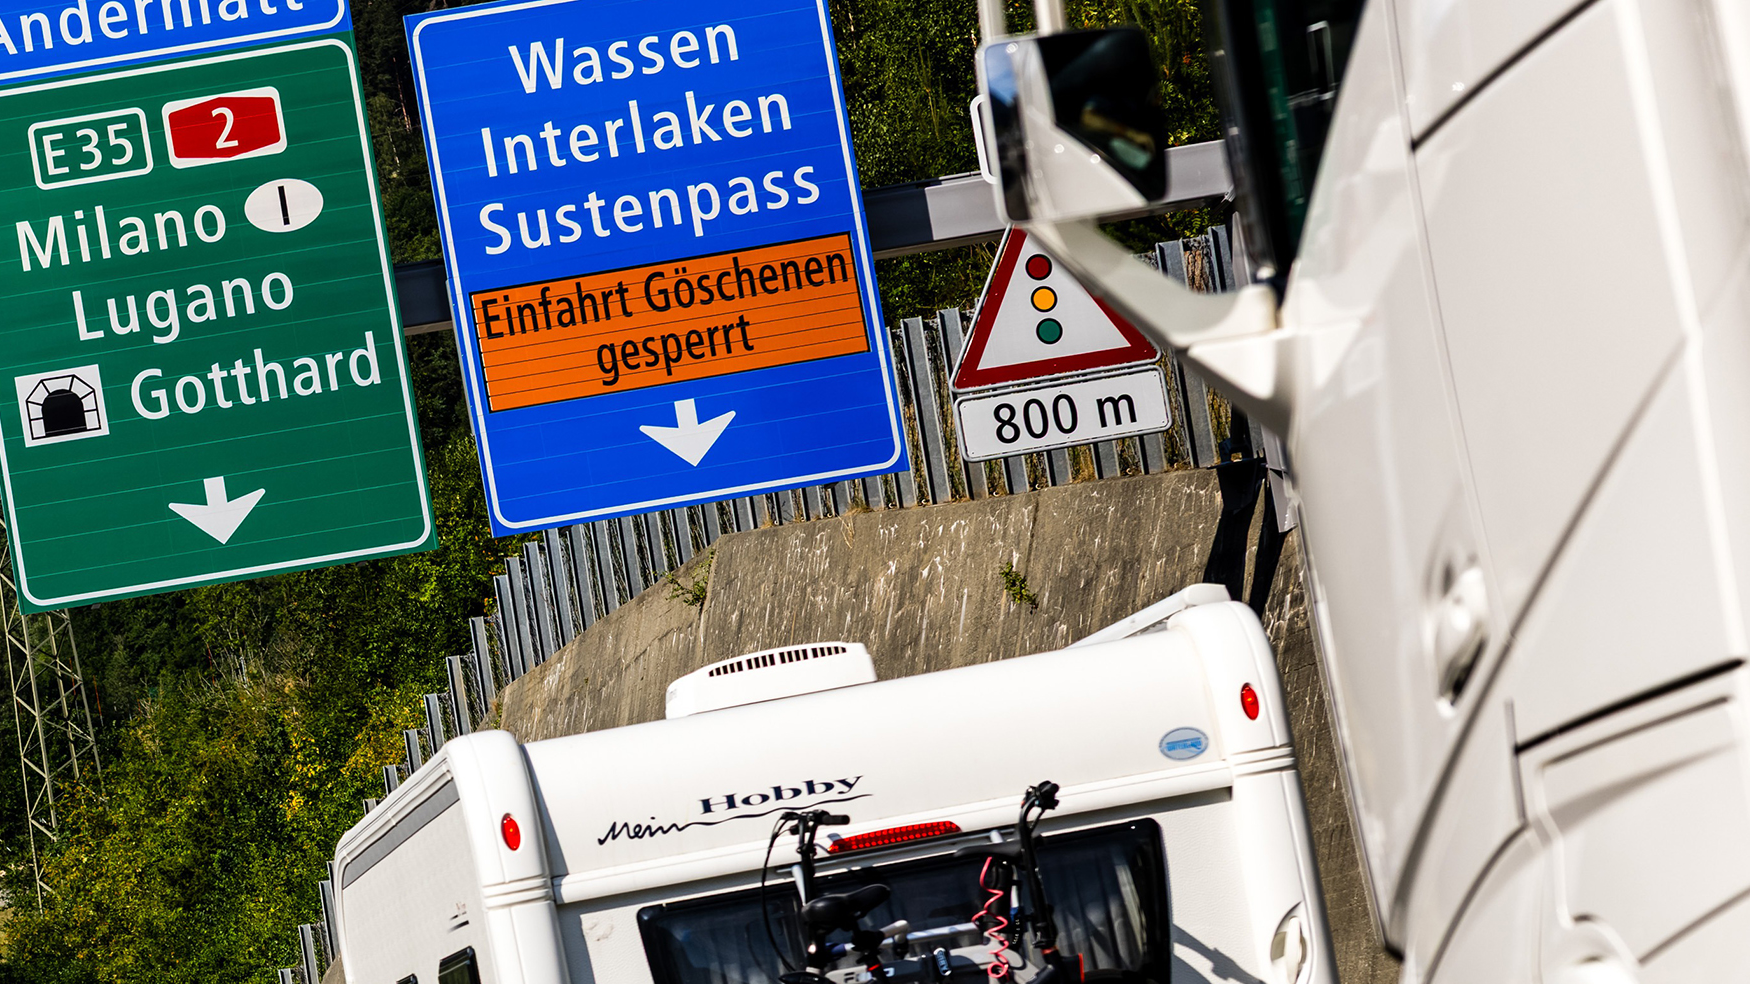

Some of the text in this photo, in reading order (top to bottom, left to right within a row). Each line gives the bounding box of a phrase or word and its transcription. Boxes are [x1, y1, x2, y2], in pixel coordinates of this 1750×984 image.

[508, 24, 739, 94] Wassen
[42, 106, 239, 176] E35 2
[481, 90, 792, 178] Interlaken
[15, 204, 226, 272] Milano
[479, 165, 820, 255] Sustenpass
[72, 272, 294, 344] Lugano
[481, 251, 849, 340] Einfahrt Göschenen
[130, 330, 381, 420] Gotthard
[596, 314, 755, 387] gesperrt
[993, 393, 1138, 444] 800 m
[598, 775, 865, 846] Mein Hobby
